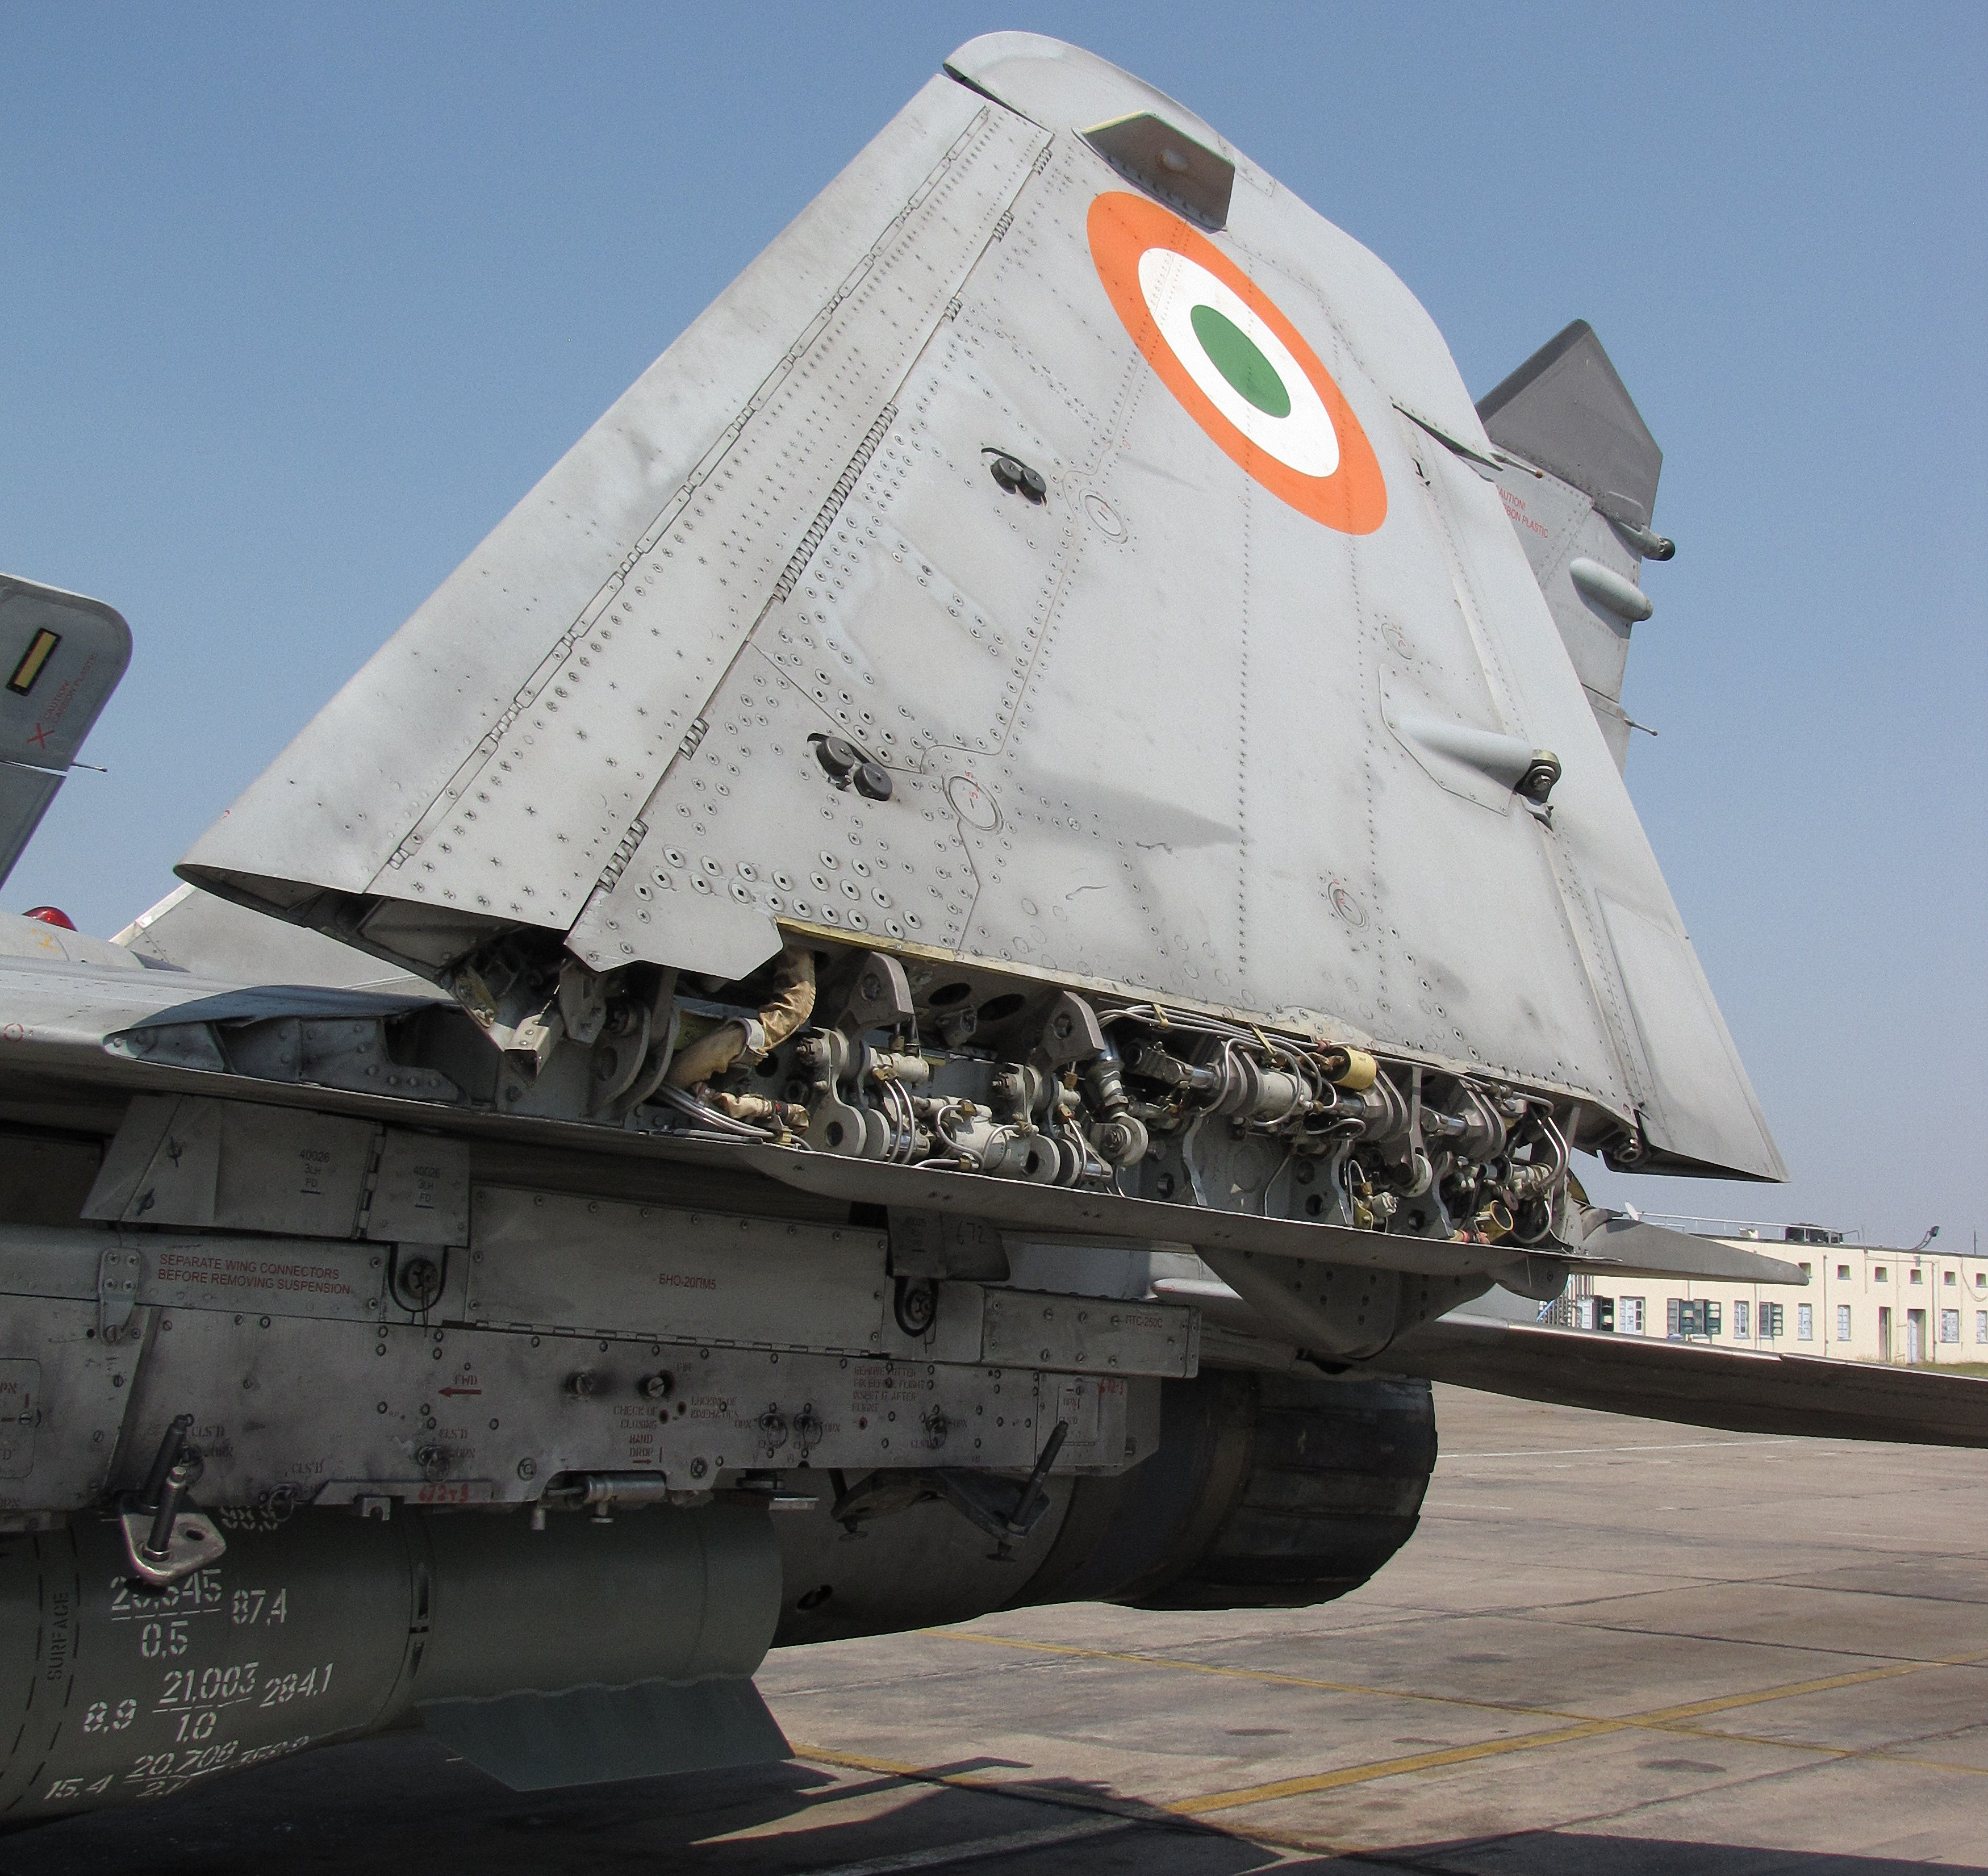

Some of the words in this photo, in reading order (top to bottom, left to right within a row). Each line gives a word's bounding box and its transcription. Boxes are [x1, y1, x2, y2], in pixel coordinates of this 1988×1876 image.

[1522, 515, 1549, 538] PLASTIC
[299, 1149, 330, 1163] 40026
[160, 1254, 222, 1270] SEPARATE
[225, 1259, 257, 1273] WING
[260, 1261, 340, 1280] CONNECTORS
[158, 1268, 207, 1284] BEFORE
[211, 1272, 274, 1289] REMOVING
[277, 1278, 350, 1295] SUSPENSION
[454, 1374, 478, 1385] FWD
[629, 1434, 653, 1444] HAND
[629, 1447, 653, 1458] DROP
[47, 1592, 69, 1681] SURFACE
